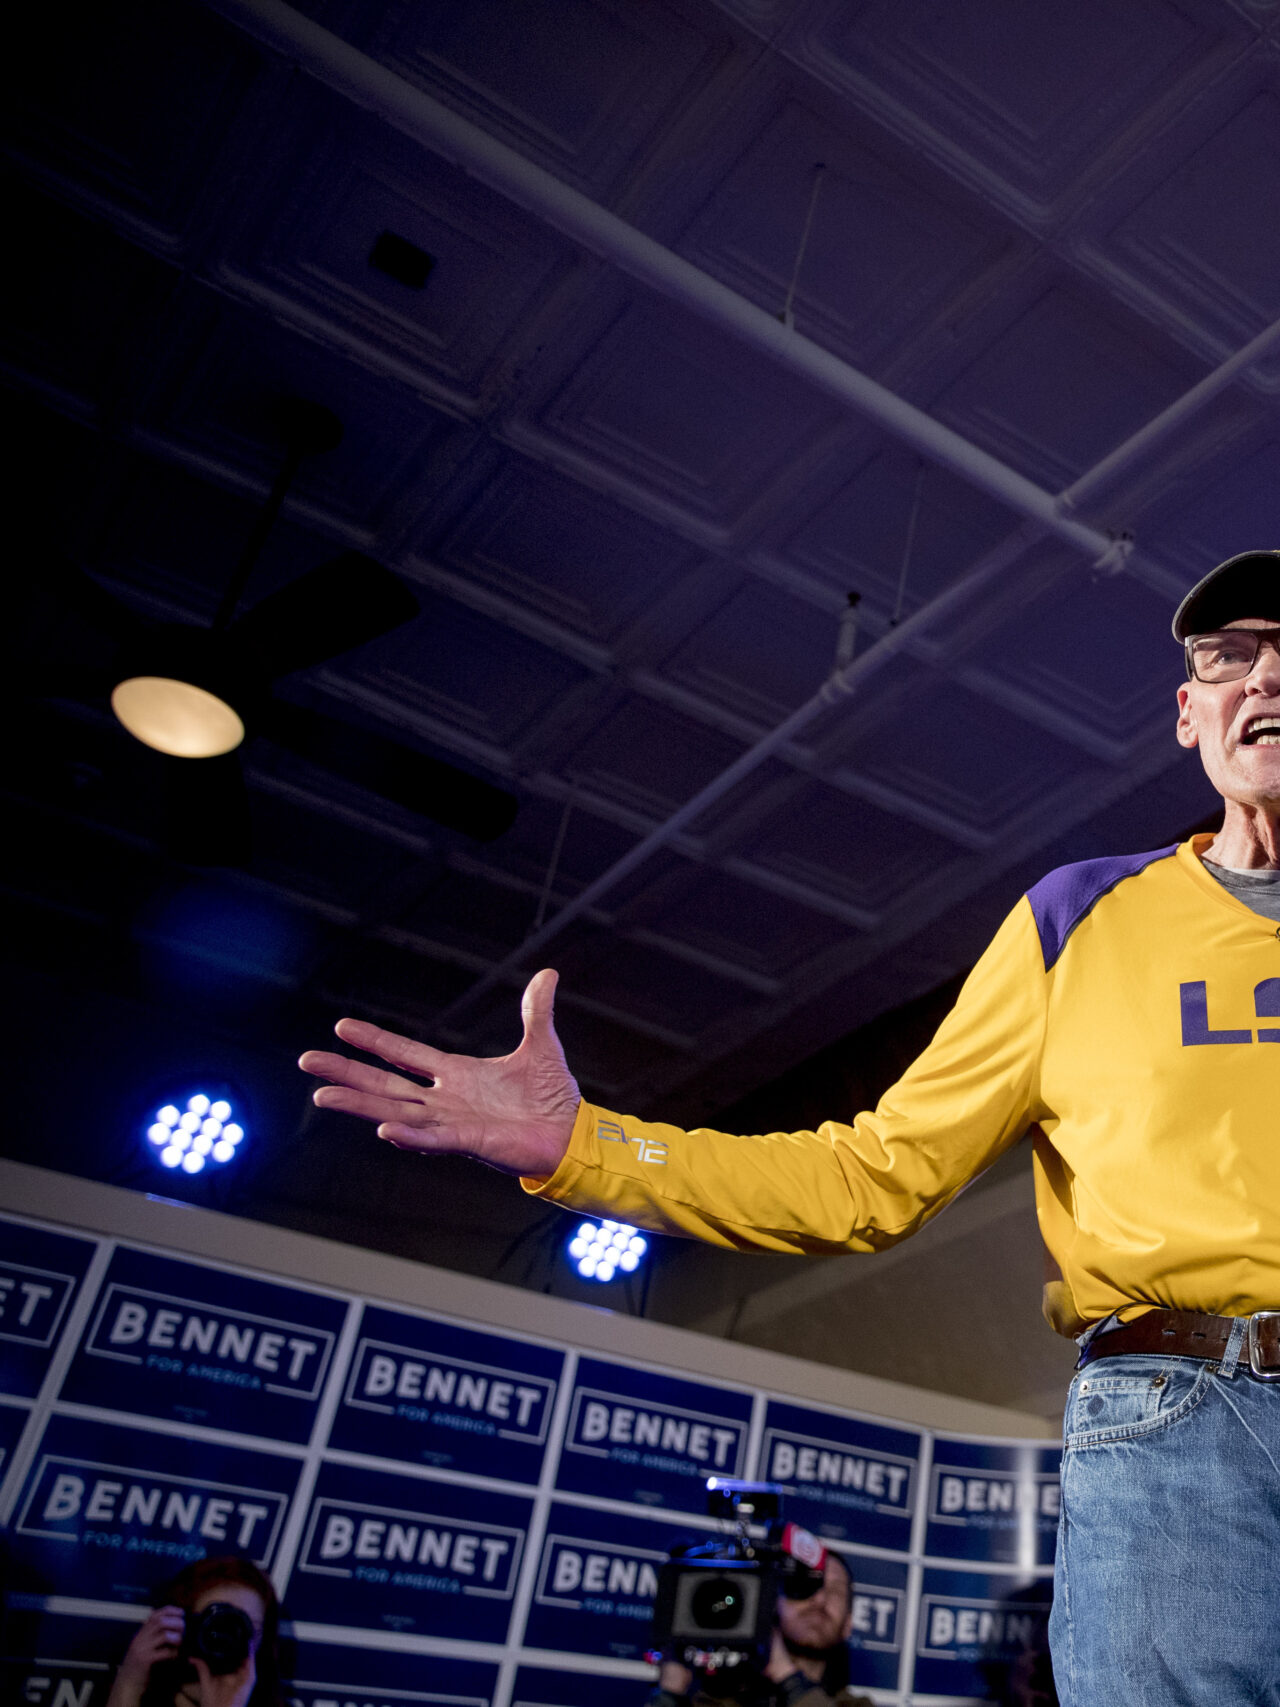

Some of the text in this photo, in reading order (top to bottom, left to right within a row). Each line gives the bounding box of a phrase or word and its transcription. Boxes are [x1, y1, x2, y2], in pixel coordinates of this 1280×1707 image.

[109, 1300, 318, 1382] BENNET
[146, 1353, 262, 1390] FOR AMERICA
[363, 1354, 542, 1427] BENNET
[396, 1404, 430, 1422] FOR
[580, 1401, 737, 1468] BENNET
[770, 1440, 908, 1503] BENNET
[939, 1475, 1061, 1517] BENE
[42, 1473, 270, 1549] BENNET
[82, 1529, 207, 1561] FOR AMERICA
[319, 1513, 510, 1582] BENNET
[355, 1565, 390, 1584] FOR
[552, 1549, 659, 1599] BENN
[930, 1606, 1033, 1647] BENN
